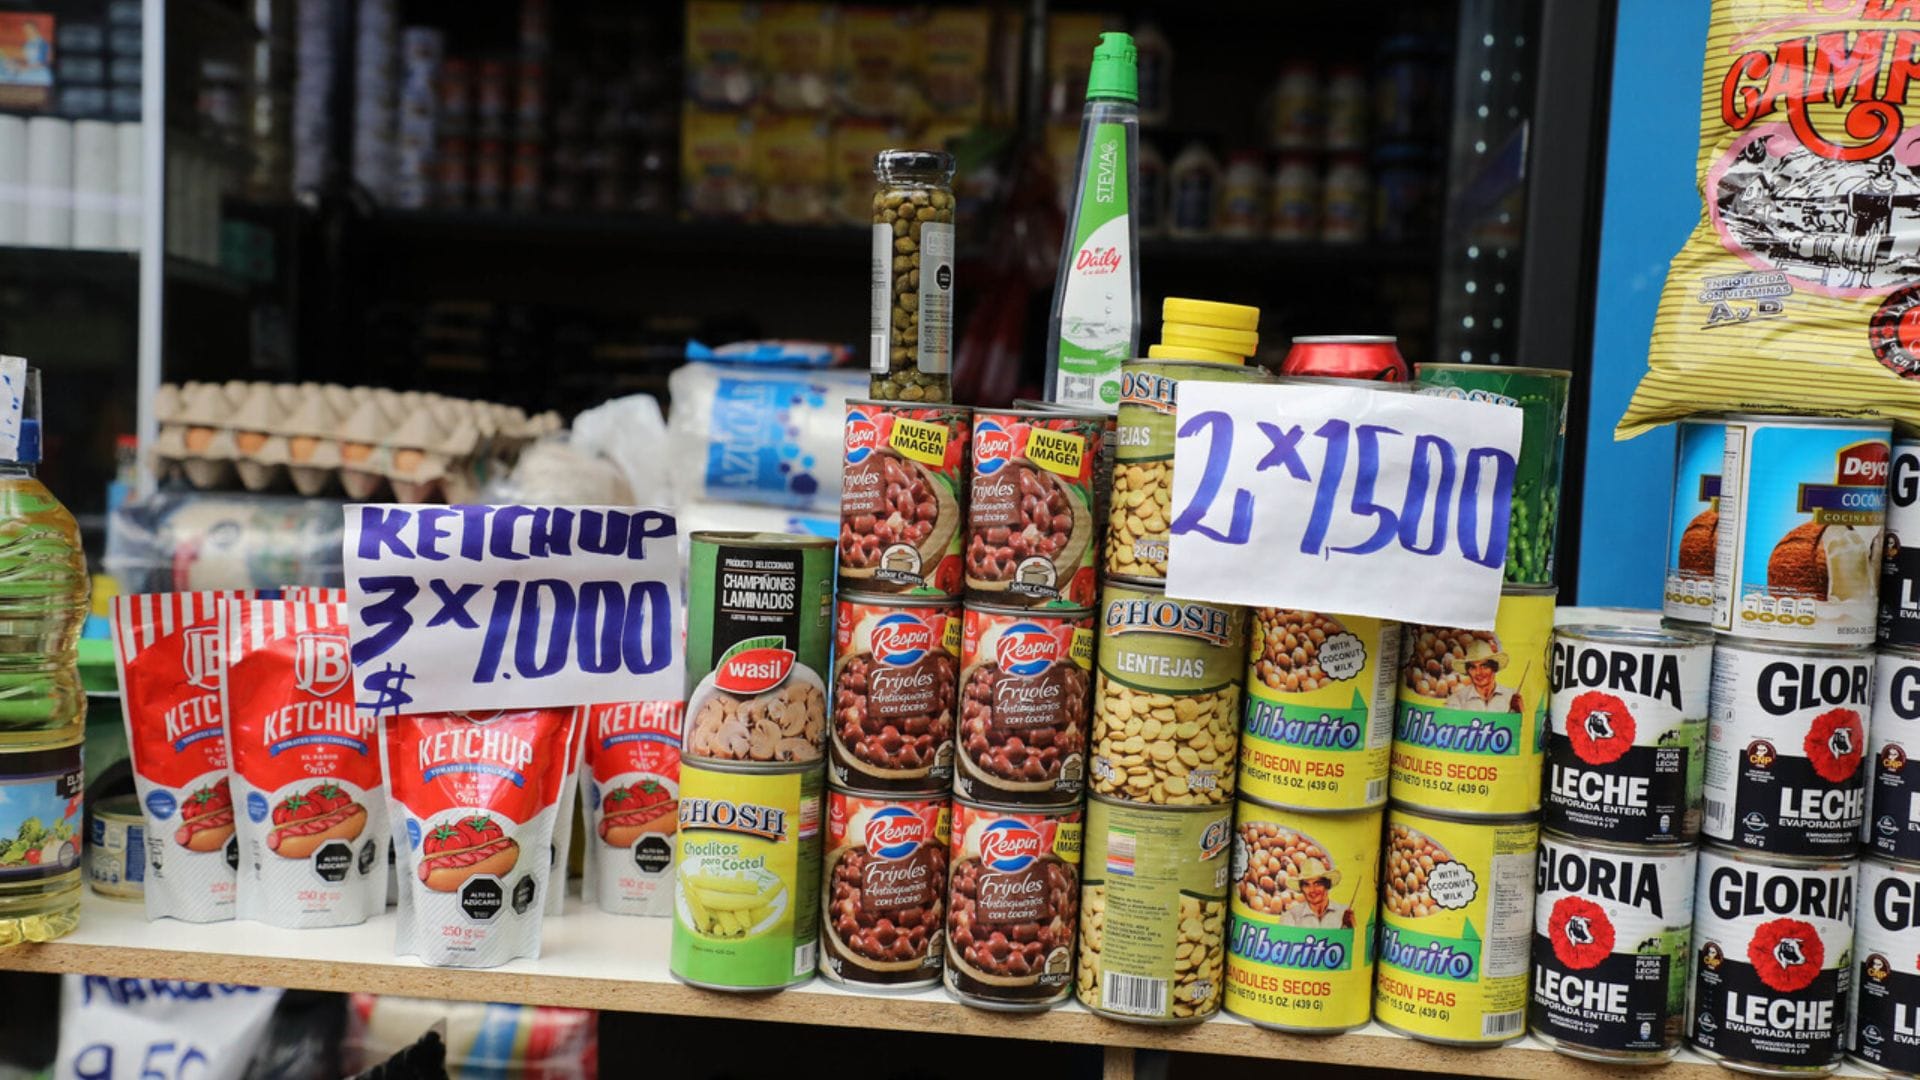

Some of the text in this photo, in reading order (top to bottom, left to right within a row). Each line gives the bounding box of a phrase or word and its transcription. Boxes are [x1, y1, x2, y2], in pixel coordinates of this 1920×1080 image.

[1097, 144, 1113, 203] STEVIA
[1076, 247, 1122, 273] Daily
[1704, 273, 1786, 289] ENRIQUECIDA
[1698, 284, 1793, 302] CON VITAMINAS
[1707, 300, 1734, 324] A
[899, 425, 942, 443] NUEVA
[893, 436, 944, 456] IMAGEN
[1035, 435, 1078, 454] NUEVA
[1030, 446, 1080, 467] IMAGEN
[357, 504, 677, 562] KETCHUP
[724, 573, 796, 591] CHAMPIÑONES
[722, 590, 794, 609] LAMINADOS
[1106, 600, 1230, 638] GHOSH
[874, 625, 928, 657] Respin
[997, 632, 1055, 668] Respin
[1329, 640, 1351, 651] WITH
[1117, 651, 1205, 680] LENTEJAS
[1322, 650, 1361, 664] COCONUT
[729, 660, 781, 680] wasil
[1334, 663, 1354, 673] MILK
[1551, 642, 1683, 712] GLORIA
[263, 700, 376, 747] KETCHUP
[1249, 700, 1361, 750] Jibarito
[1400, 707, 1513, 755] Jibarito
[418, 728, 534, 771] KETCHUP
[1656, 752, 1680, 760] PURA
[1254, 751, 1301, 775] PIGEON
[1305, 761, 1345, 778] PEAS
[1447, 763, 1498, 782] SECOS
[1272, 774, 1290, 786] 15.5
[1307, 779, 1327, 792] (439
[1422, 778, 1438, 791] 15.5
[1457, 783, 1478, 795] (439
[1551, 764, 1649, 808] LECHE
[1603, 805, 1647, 817] ENTERA
[1779, 786, 1865, 820] LECHE
[868, 815, 922, 850] Respin
[1778, 818, 1842, 829] EVAPORADA
[684, 841, 738, 856] Choclitos
[982, 826, 1039, 863] Respin
[722, 856, 765, 871] Coctel
[1438, 870, 1460, 880] WITH
[1536, 843, 1664, 920] GLORIA
[1431, 878, 1472, 892] COCONUT
[1443, 890, 1463, 901] MILK
[1231, 920, 1346, 970] Jibarito
[1635, 967, 1660, 975] LECHE
[1636, 959, 1661, 968] PURA
[1282, 979, 1331, 996] SECOS
[1535, 964, 1630, 1014] LECHE
[1257, 993, 1274, 1005] 15.5
[1292, 998, 1312, 1011] (439
[1417, 989, 1456, 1008] PEAS
[1418, 1008, 1438, 1020] (439
[1583, 1009, 1627, 1023] ENTERA
[1725, 990, 1834, 1032] LECHE
[1725, 1020, 1832, 1040] EVAPORADA ENTERA
